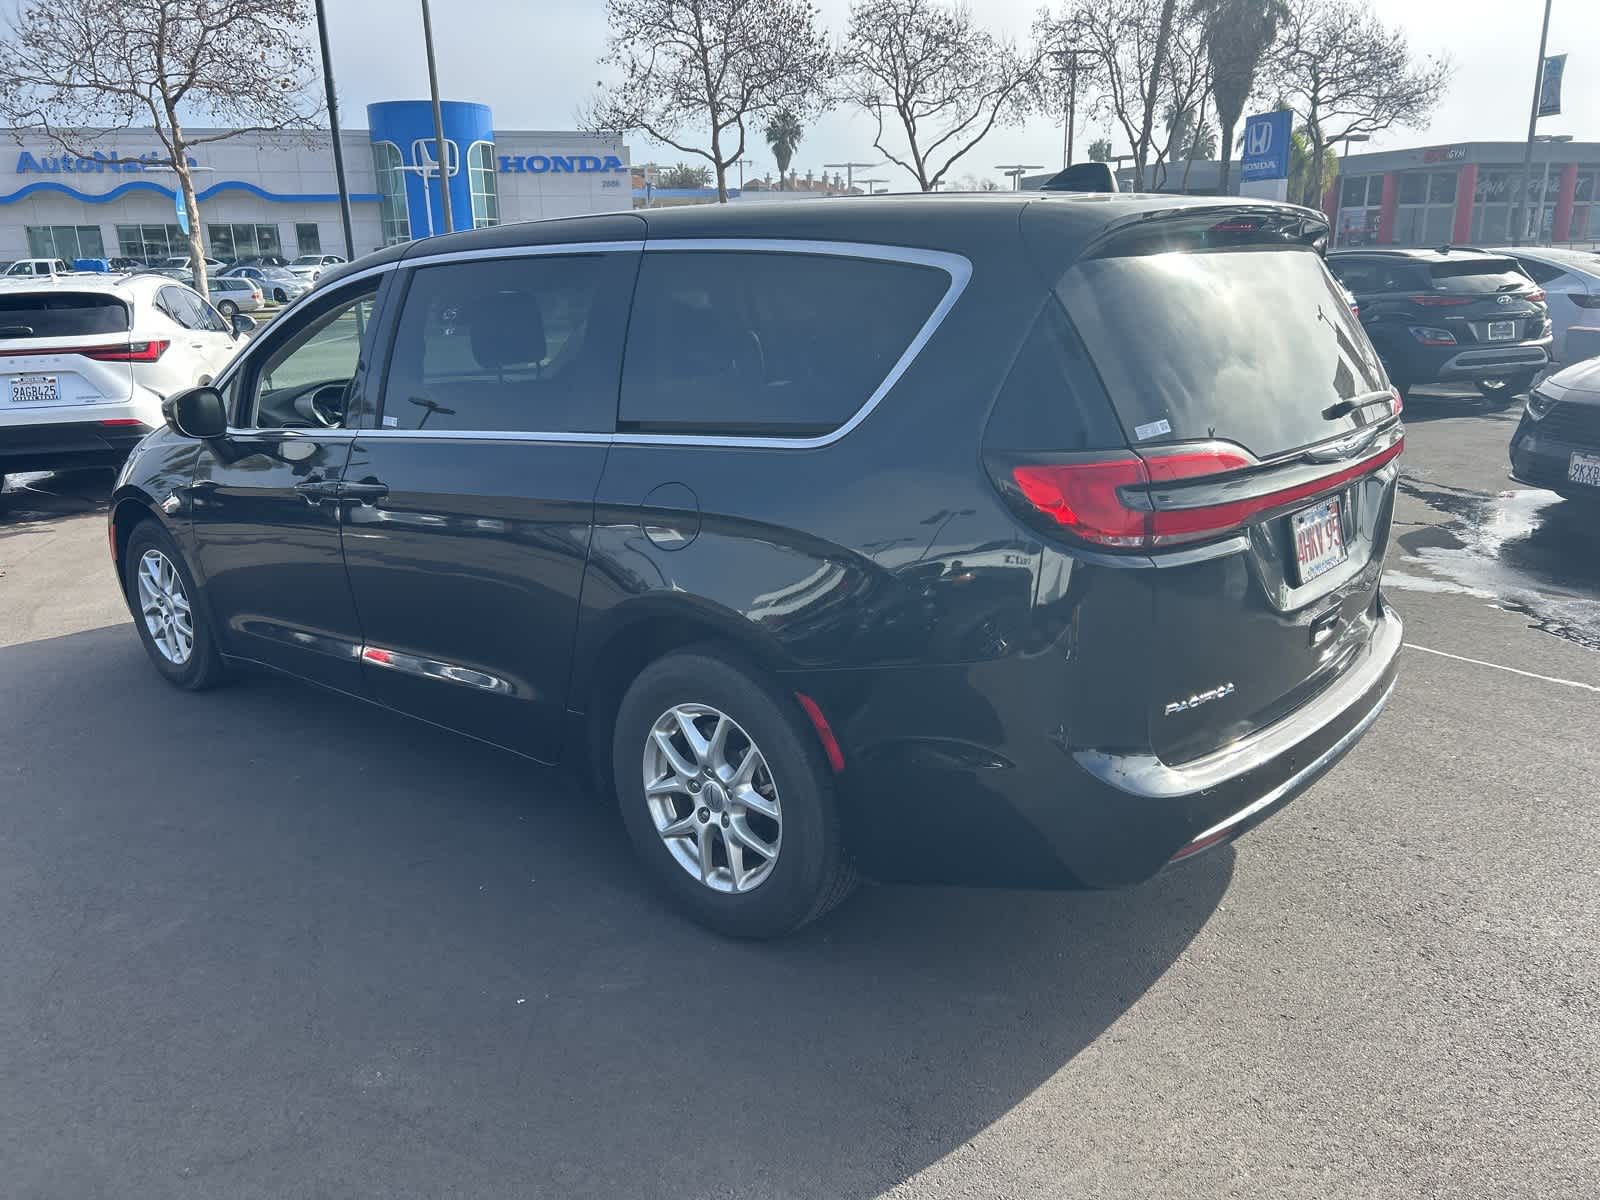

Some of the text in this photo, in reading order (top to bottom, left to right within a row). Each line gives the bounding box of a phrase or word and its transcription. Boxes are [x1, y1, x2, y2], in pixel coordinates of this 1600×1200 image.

[16, 151, 628, 174] AutoNati HONDA
[13, 385, 56, 398] 9AGB425
